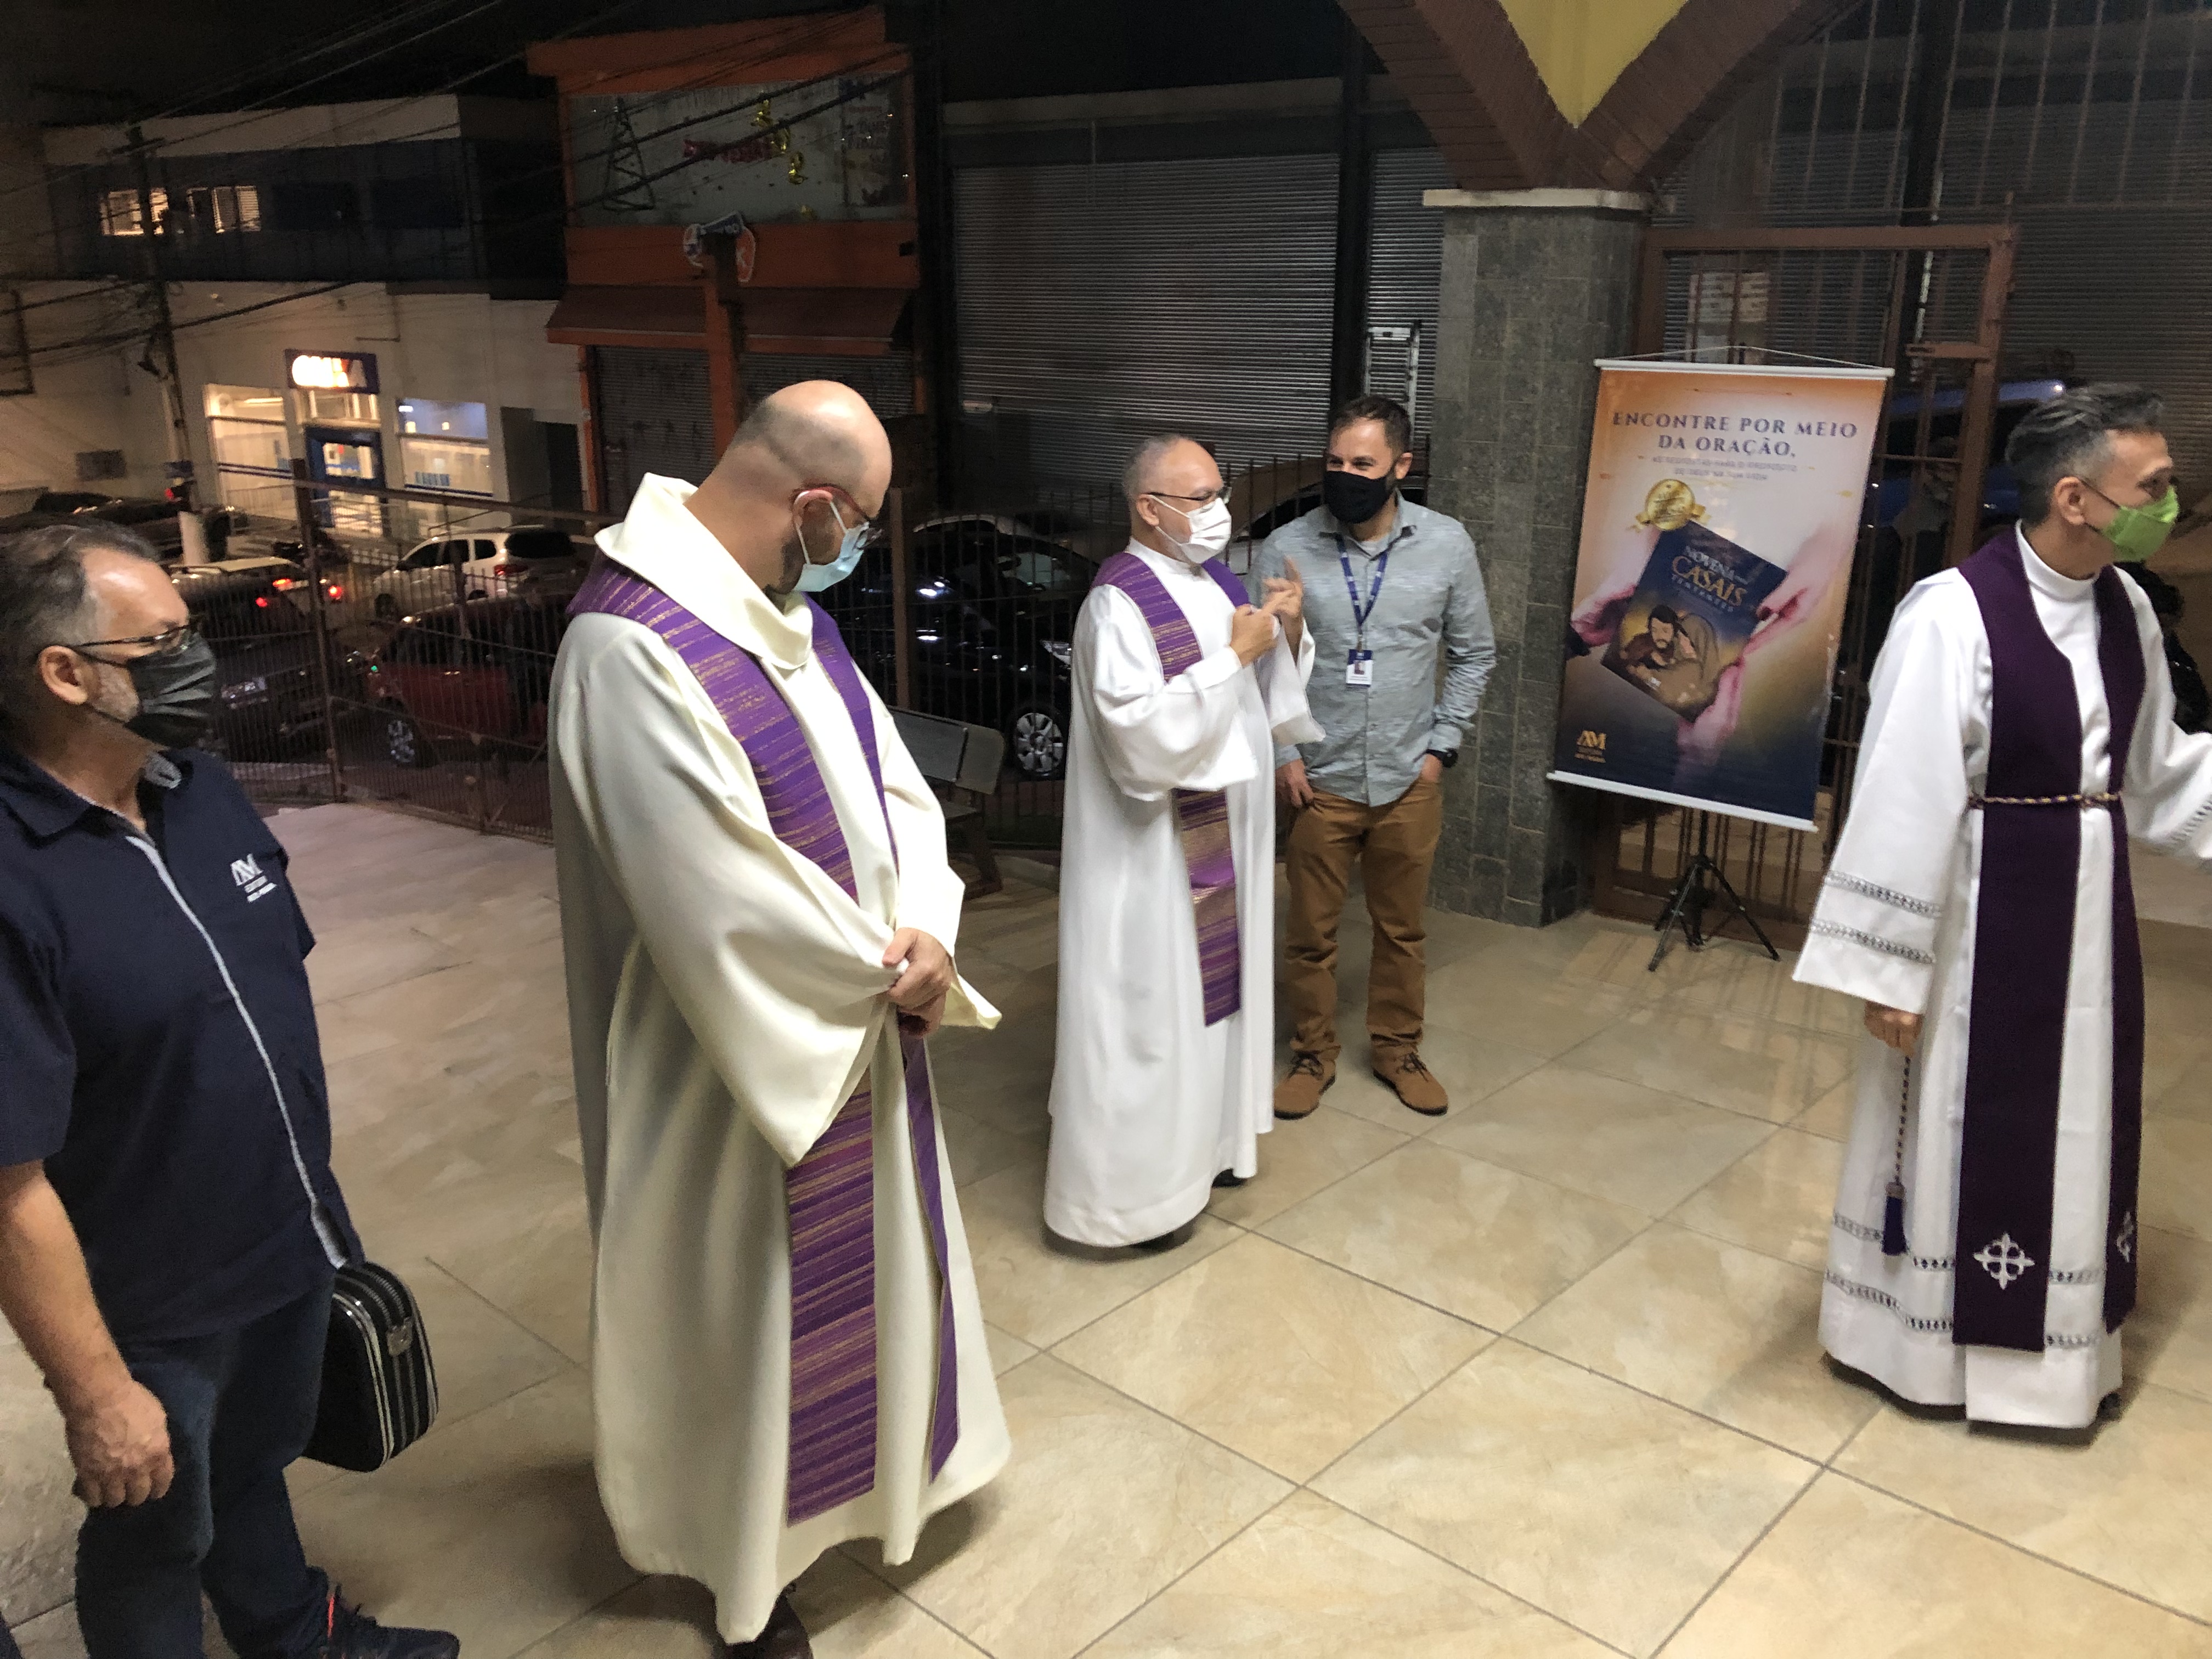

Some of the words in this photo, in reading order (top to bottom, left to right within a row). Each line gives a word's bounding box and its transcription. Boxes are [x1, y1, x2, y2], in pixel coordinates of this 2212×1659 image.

[1612, 411, 1730, 431] ENCONTRE
[1739, 416, 1786, 435] POR
[1795, 421, 1858, 439] MEIO
[1657, 435, 1686, 450] DA
[1672, 555, 1748, 607] CASAIS
